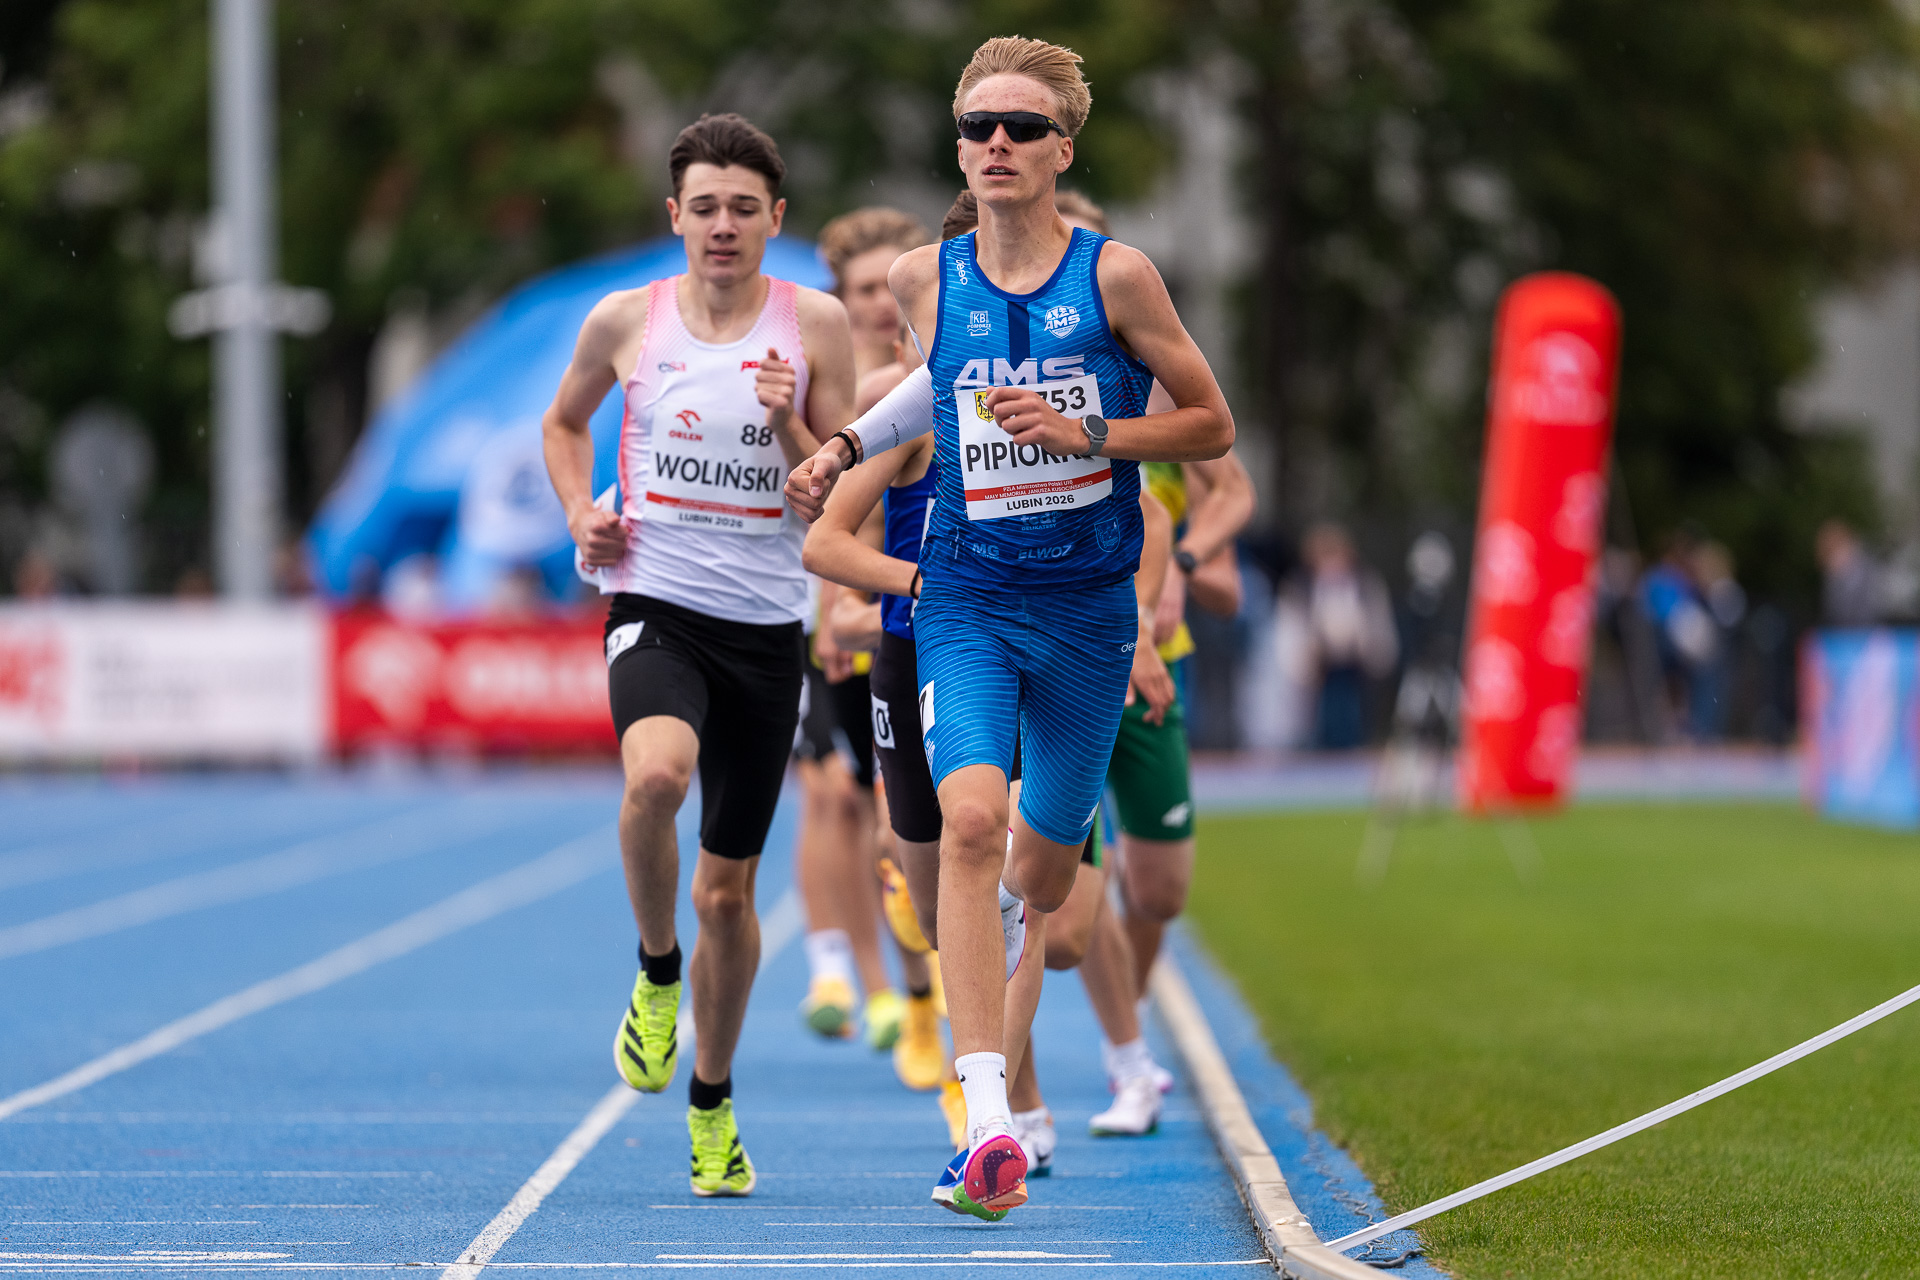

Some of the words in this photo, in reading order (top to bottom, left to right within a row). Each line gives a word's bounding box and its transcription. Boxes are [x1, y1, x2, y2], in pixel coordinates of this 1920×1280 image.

[973, 313, 986, 324] KB
[1044, 313, 1081, 331] AMS
[952, 354, 1085, 389] AMS
[668, 430, 703, 442] ORLEN
[741, 424, 773, 447] 88
[656, 452, 780, 492] WOLIŃSKI
[1006, 497, 1043, 511] LUBIN
[1045, 494, 1075, 506] 2026
[678, 512, 712, 524] LUBIN
[715, 516, 744, 529] 2026
[1021, 522, 1057, 531] DELIKATESY
[972, 543, 1000, 557] MG
[1018, 544, 1072, 560] ELWOZ
